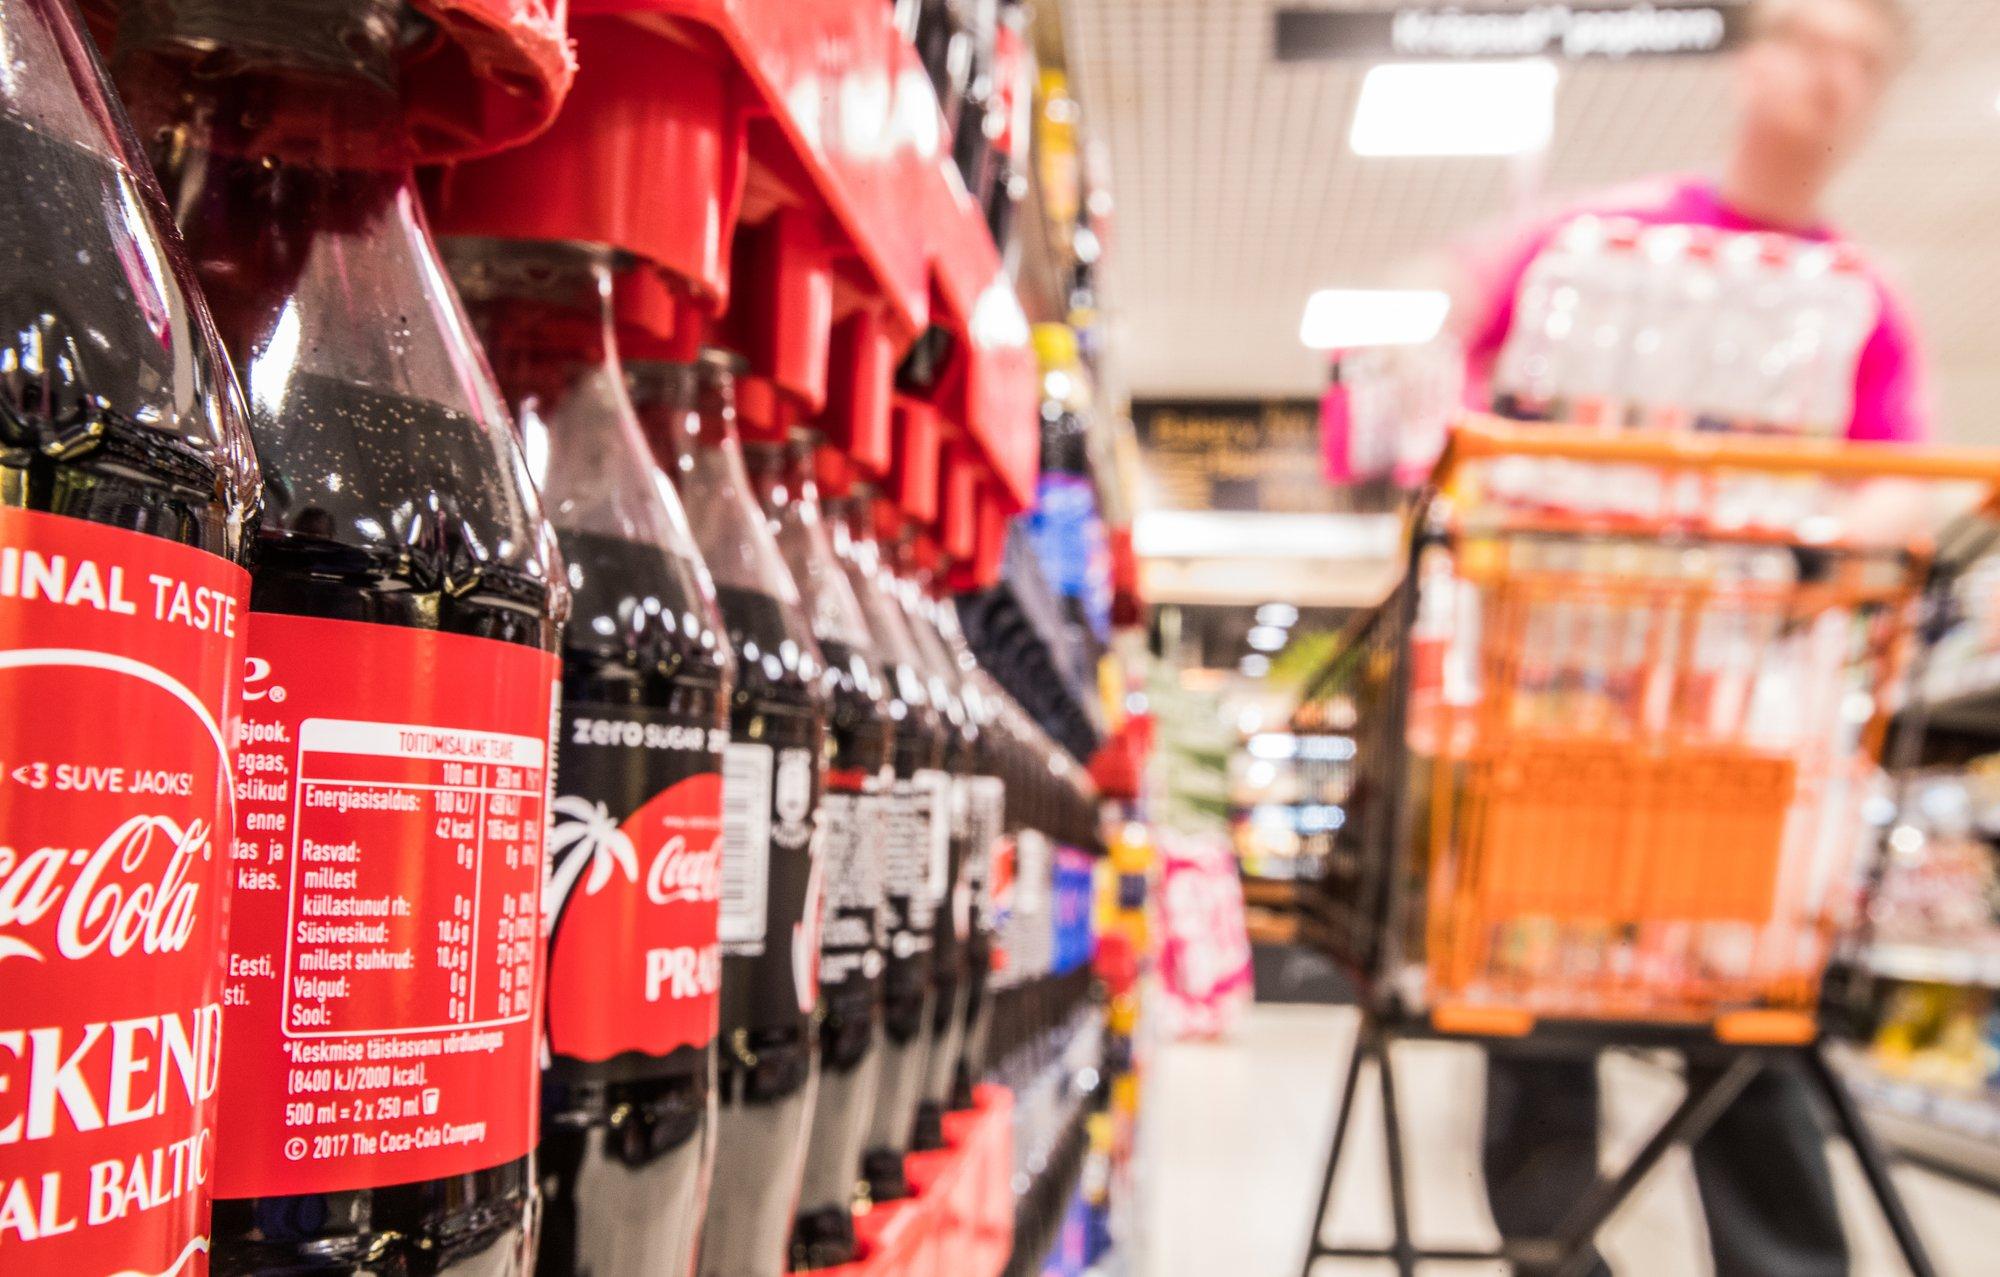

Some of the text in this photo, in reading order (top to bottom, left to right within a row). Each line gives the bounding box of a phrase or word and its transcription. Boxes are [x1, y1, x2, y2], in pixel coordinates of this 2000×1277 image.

[149, 574, 237, 638] TASTE
[572, 718, 644, 748] zero
[55, 764, 124, 793] SUVE
[129, 770, 193, 796] JAOKS!
[443, 762, 462, 785] 100
[305, 784, 421, 813] Energiasisaldus:
[246, 812, 286, 831] enne
[267, 838, 284, 865] ja
[302, 838, 361, 862] Rasvad:
[238, 867, 281, 890] käes.
[304, 867, 357, 889] millest
[302, 893, 389, 917] küllastunud
[297, 920, 390, 944] Süsivesikud:
[230, 954, 276, 979] Eesti,
[299, 948, 414, 971] millest suhkrud:
[294, 976, 350, 1003] Valgud:
[292, 1003, 331, 1026] Sool:
[288, 1068, 331, 1095] (8400
[334, 1065, 391, 1092] kJ/2000
[285, 1102, 314, 1127] 500
[317, 1101, 337, 1124] ml
[353, 1099, 364, 1122] 2
[364, 1103, 374, 1121] x
[376, 1095, 401, 1120] 250
[403, 1095, 420, 1117] ml
[312, 1133, 349, 1159] 2017
[352, 1132, 378, 1156] The
[380, 1126, 441, 1153] Coca-Cola
[87, 1128, 210, 1226] BALTIC
